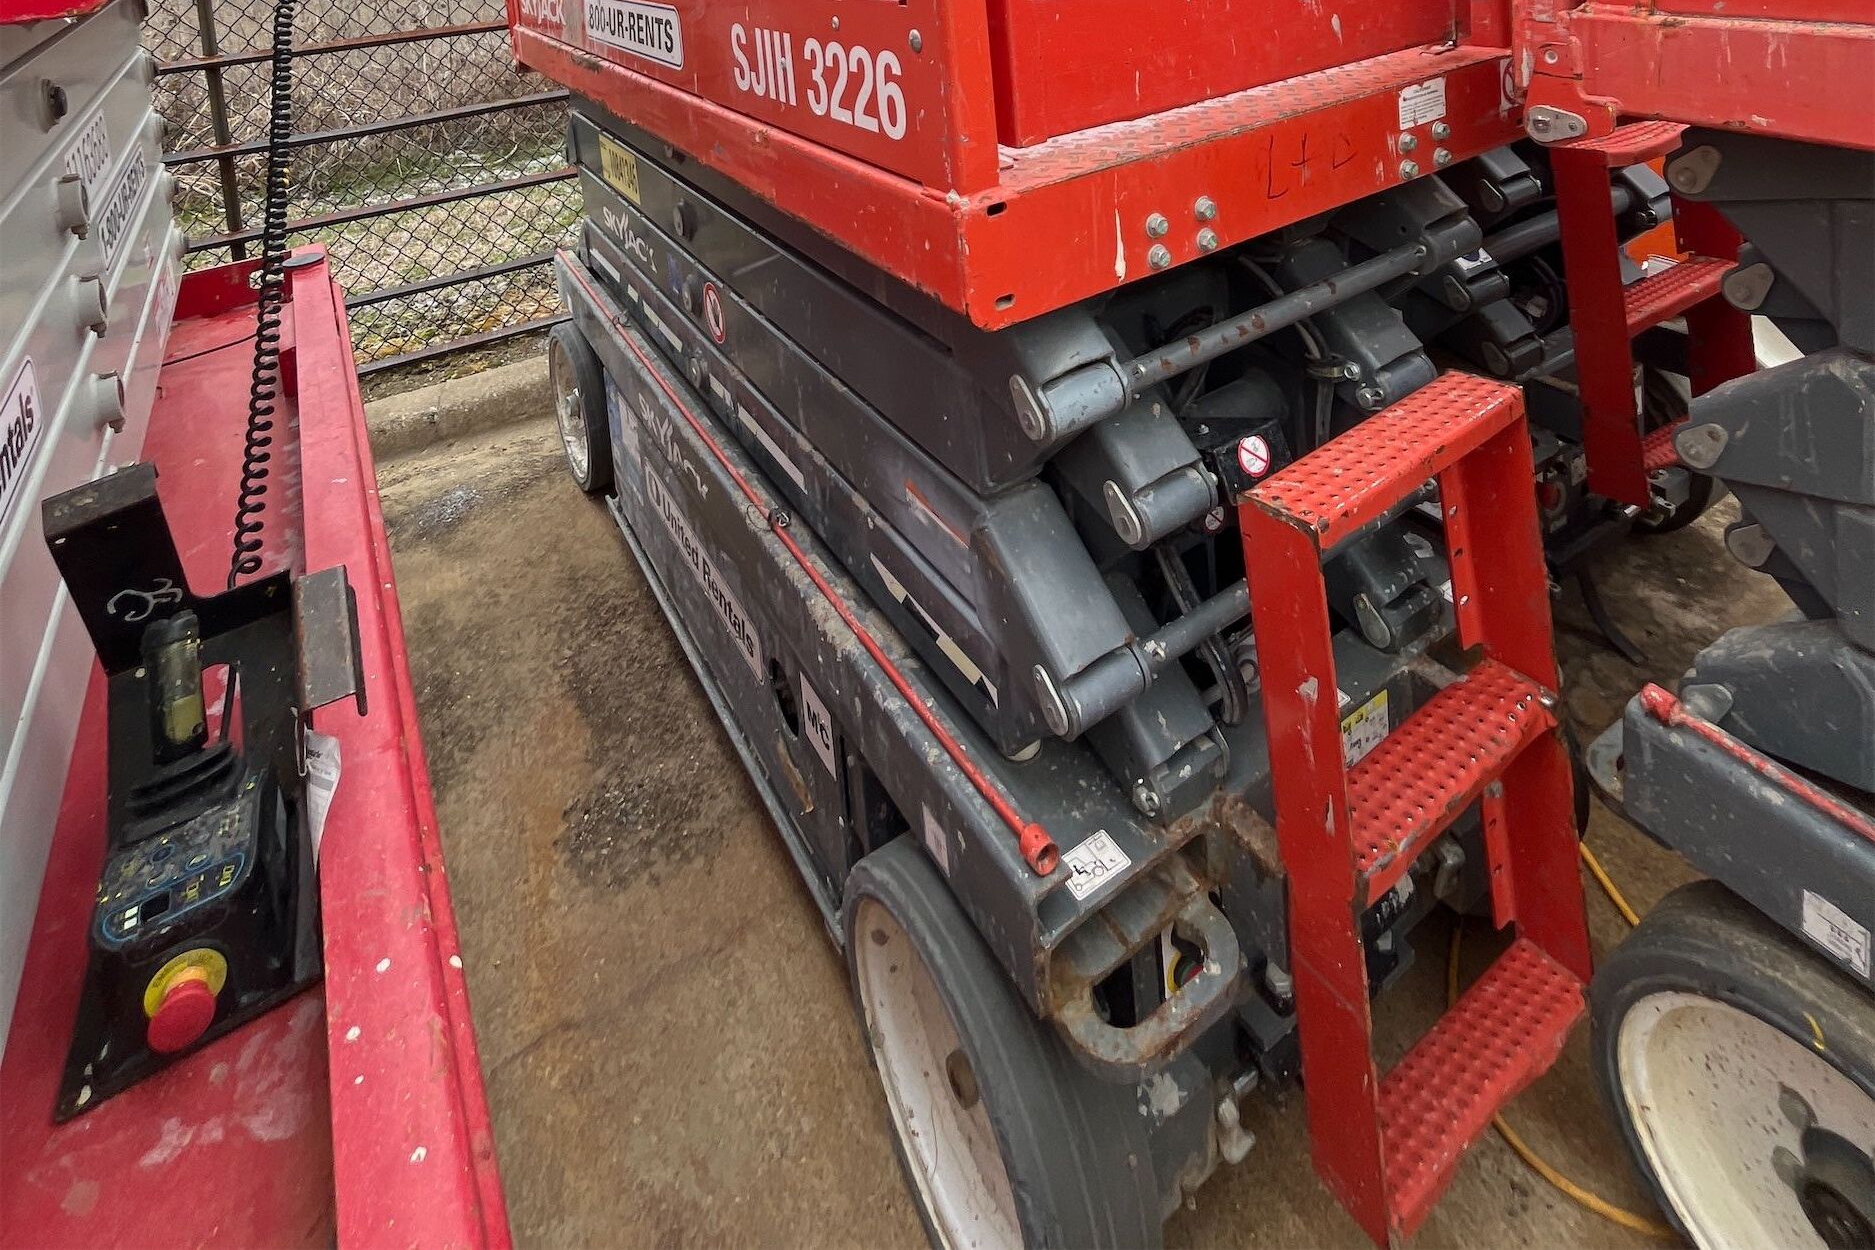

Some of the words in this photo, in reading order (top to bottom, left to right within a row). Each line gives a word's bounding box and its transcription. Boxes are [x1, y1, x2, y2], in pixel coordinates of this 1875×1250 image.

[589, 3, 674, 53] 800-UR-RENTS
[803, 37, 907, 140] 3226
[0, 392, 35, 495] ntals
[662, 493, 700, 571] United
[702, 556, 754, 659] Rentals
